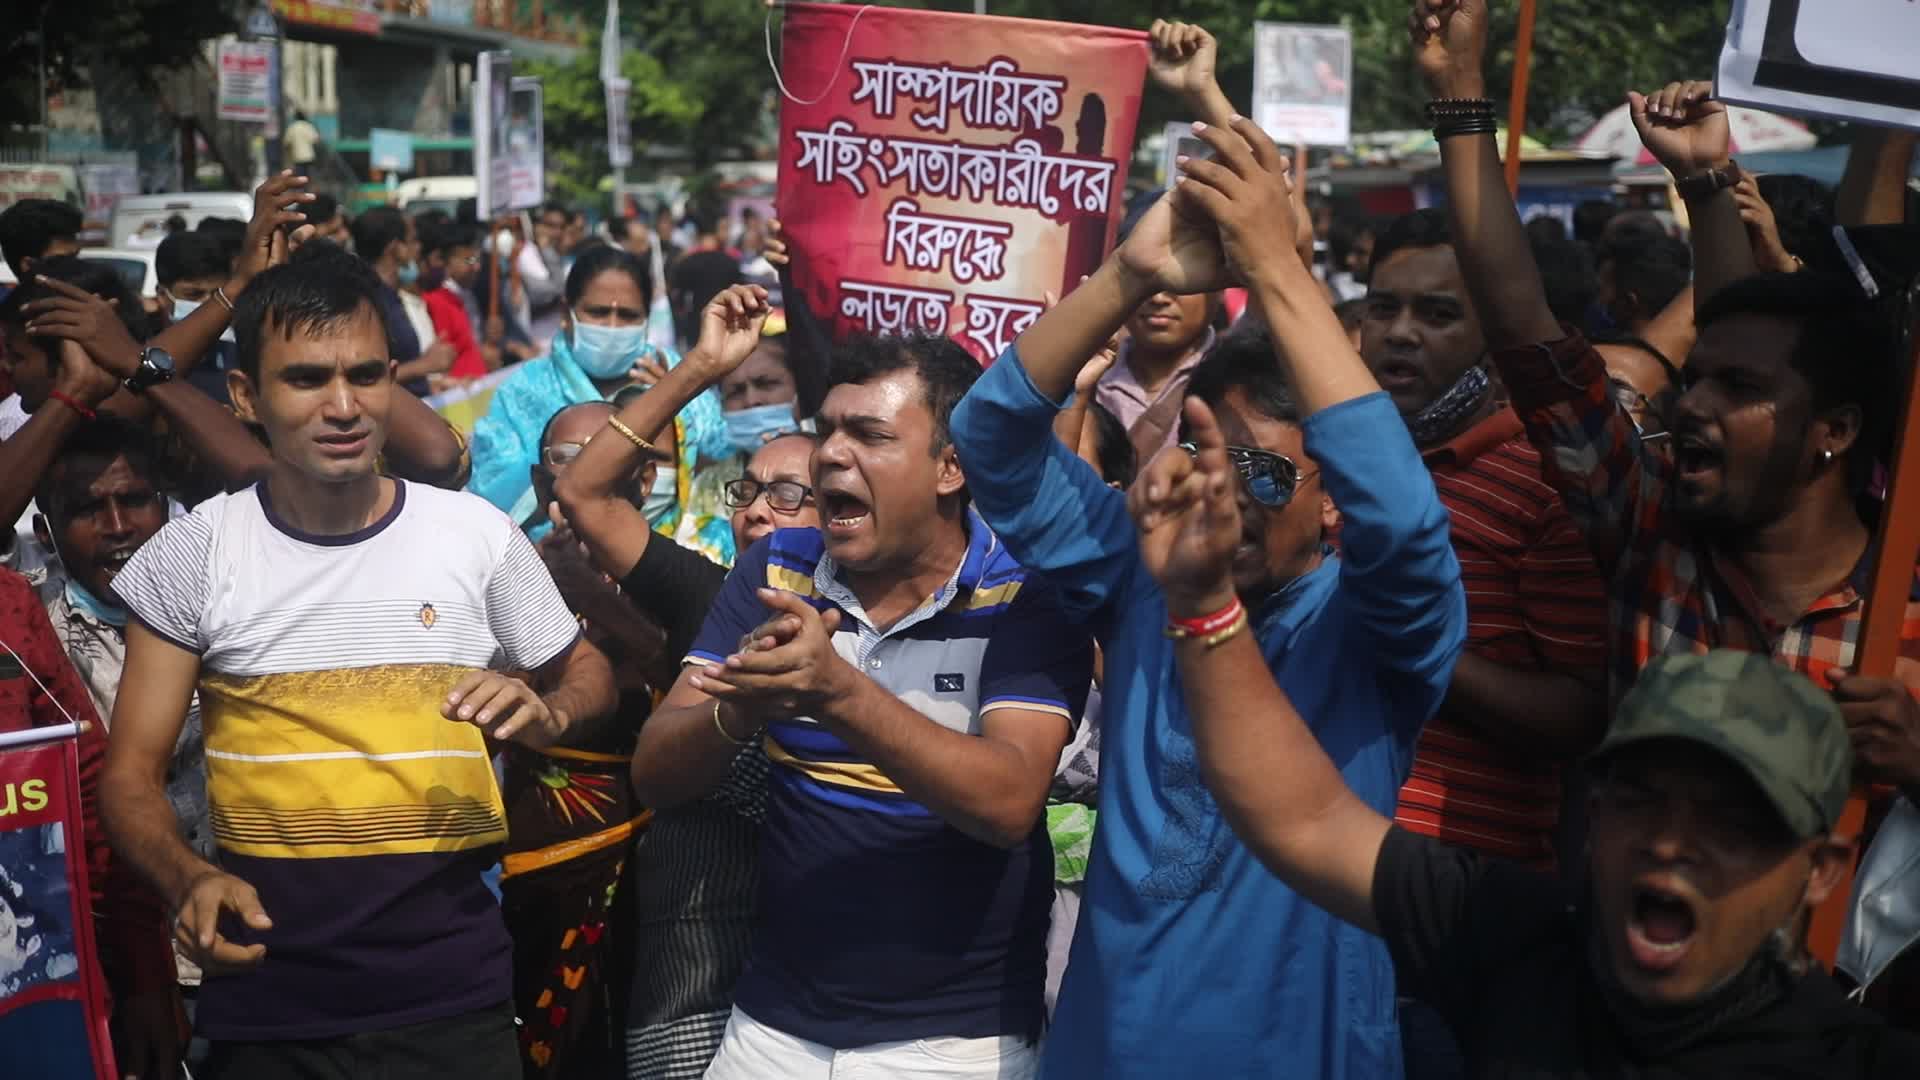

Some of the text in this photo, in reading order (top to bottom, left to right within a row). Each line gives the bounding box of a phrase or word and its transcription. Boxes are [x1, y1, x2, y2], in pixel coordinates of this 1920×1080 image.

[853, 60, 1064, 130] সাম্প্রদায়িক
[796, 121, 1115, 214] সহিংসতাকারীদের
[886, 201, 1010, 280] বিরুদ্ধে
